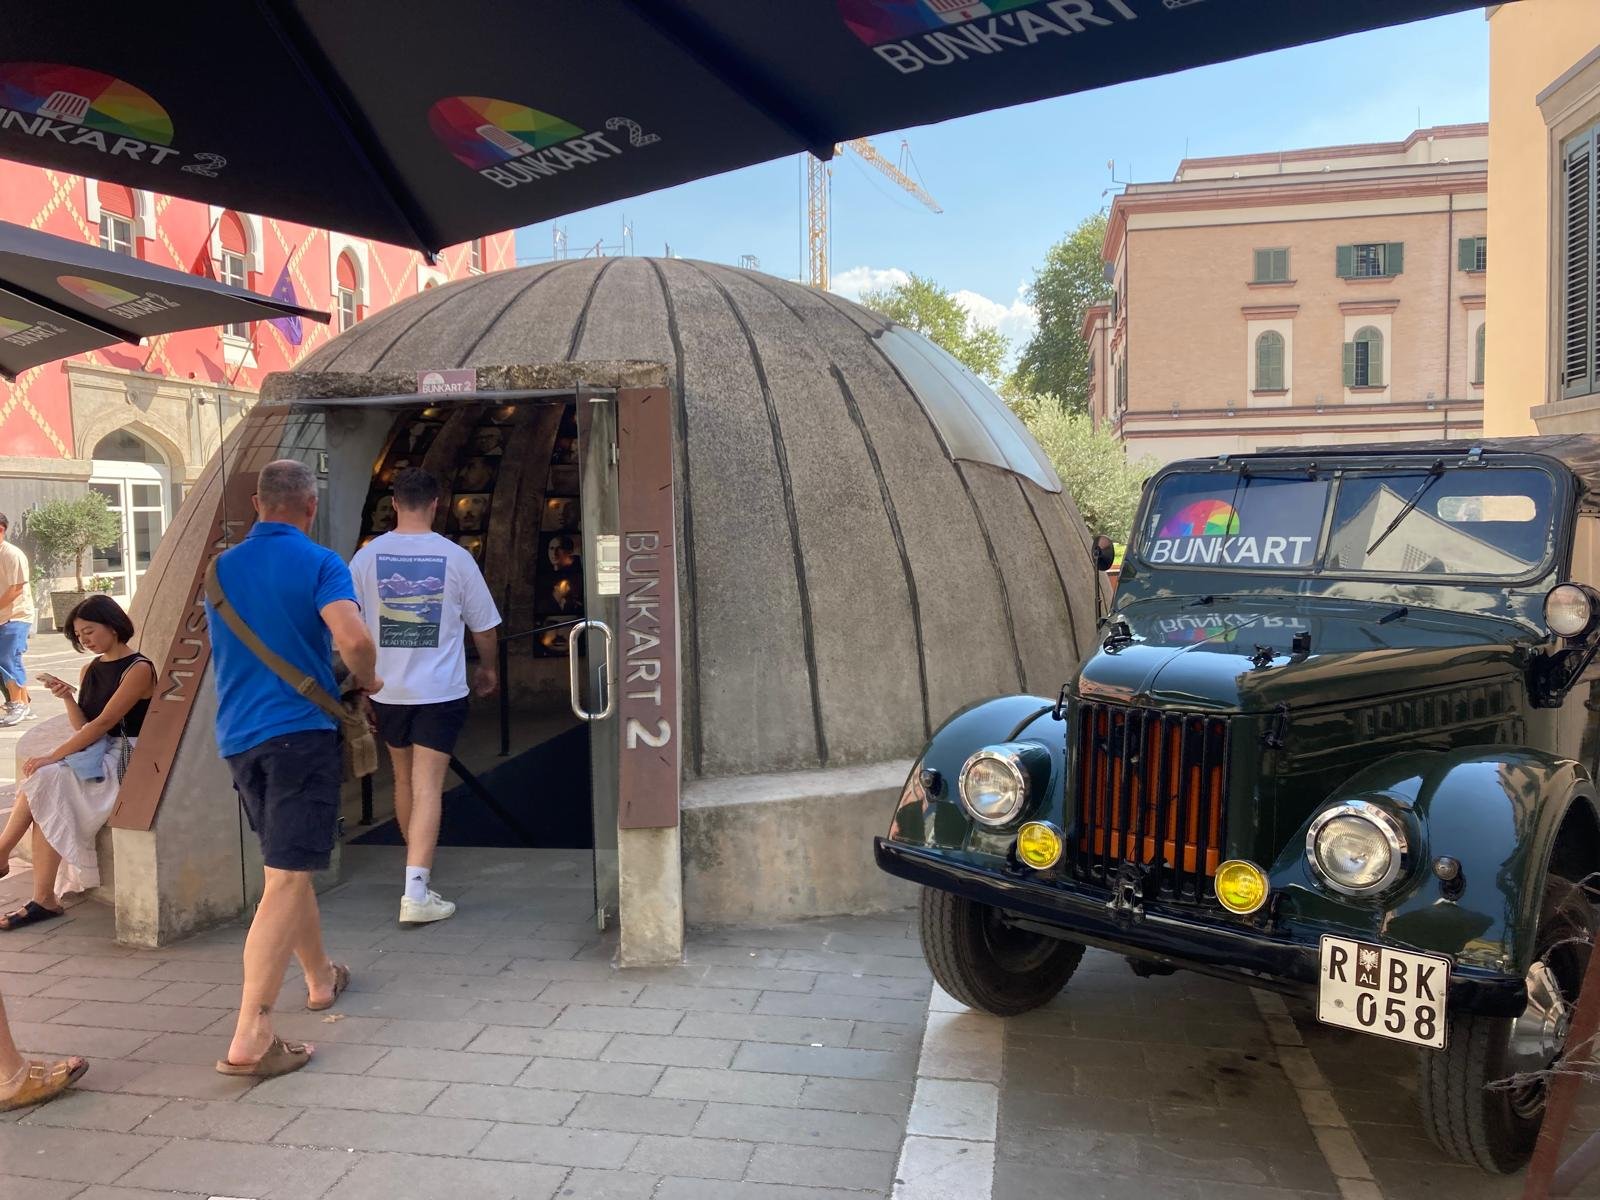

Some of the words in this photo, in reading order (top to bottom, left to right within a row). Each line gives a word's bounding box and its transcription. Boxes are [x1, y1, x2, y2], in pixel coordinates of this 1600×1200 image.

[0, 108, 180, 165] NK'ART
[181, 152, 227, 178] 2
[479, 131, 623, 189] BUNK'ART
[605, 117, 661, 147] 2
[463, 380, 472, 391] 2
[1150, 536, 1311, 564] BUNK'ART
[160, 519, 245, 701] MUSM
[625, 530, 662, 705] BUNK'ART
[626, 717, 671, 750] 2
[1329, 945, 1348, 983] R
[1359, 973, 1378, 986] AL
[1388, 957, 1436, 1001] BK
[1356, 992, 1437, 1041] 058
